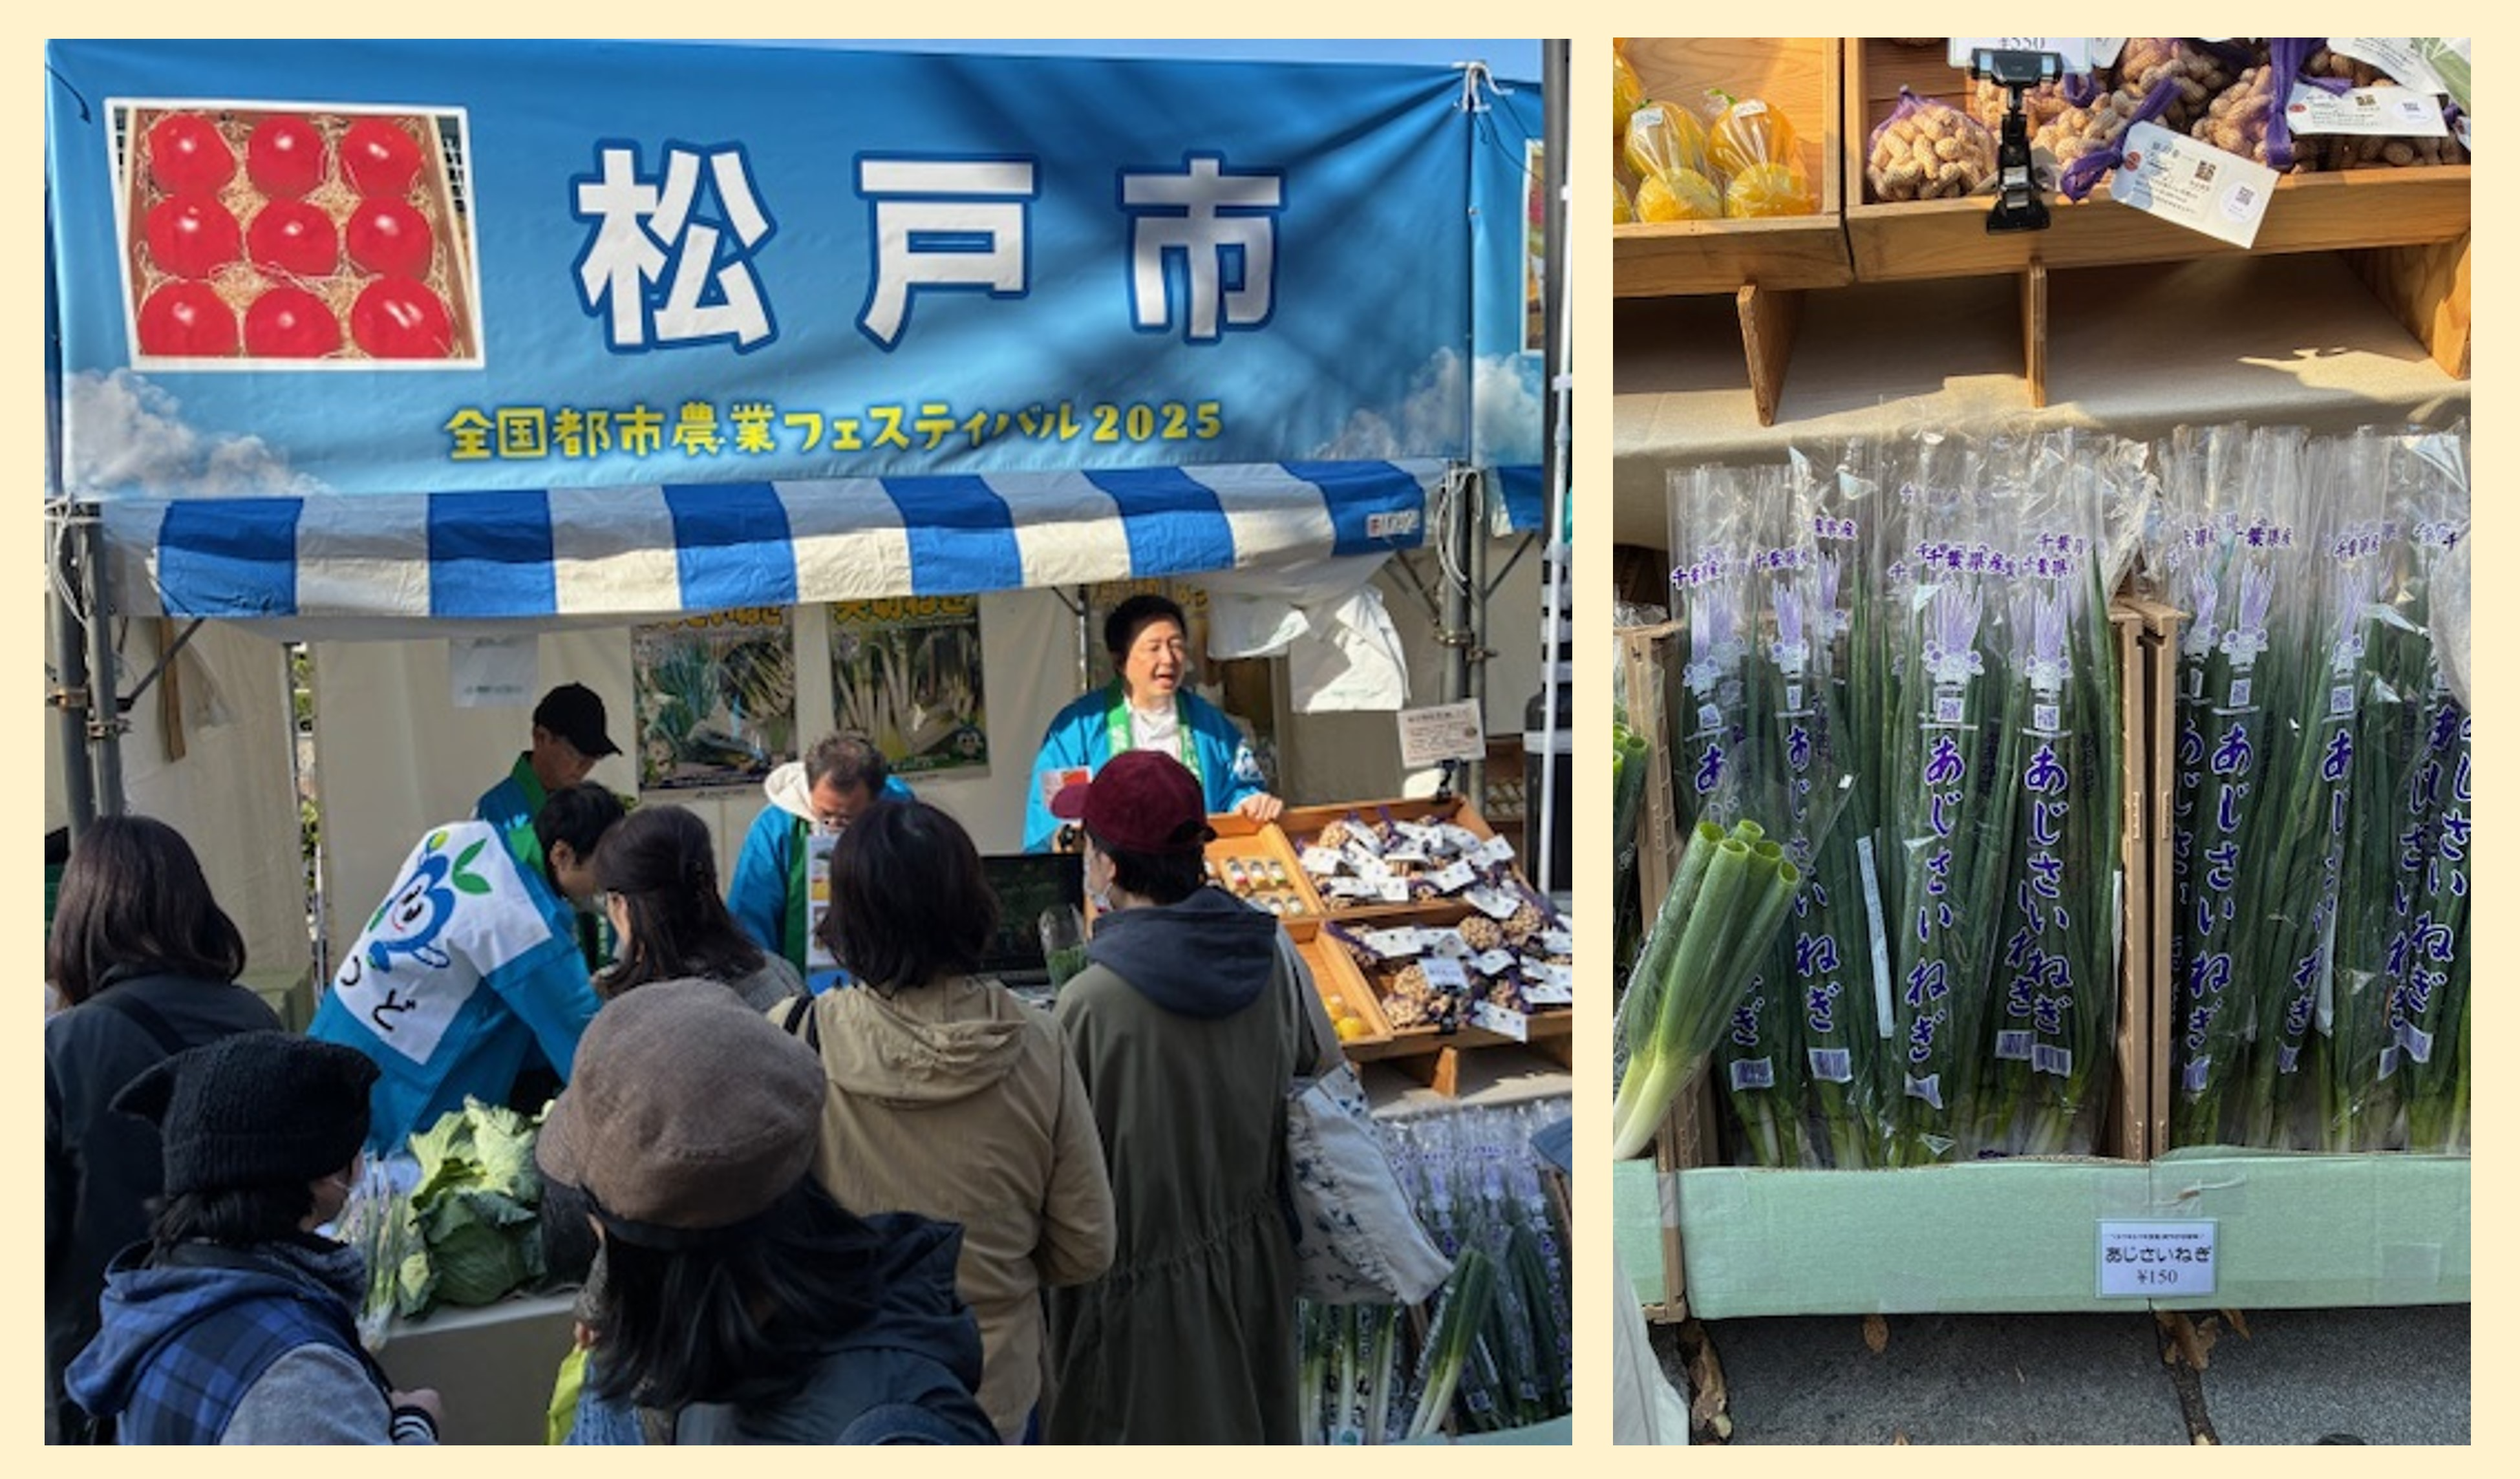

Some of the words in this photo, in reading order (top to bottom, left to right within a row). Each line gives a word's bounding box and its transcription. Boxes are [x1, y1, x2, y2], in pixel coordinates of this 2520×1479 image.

[573, 144, 1285, 350] 松戸市
[1927, 548, 2003, 571] 千葉県産
[1902, 733, 1967, 1063] あじさいねぎ
[2021, 743, 2075, 1036] あじさいねぎ
[2187, 721, 2254, 1051] あじさいねぎ
[2105, 1245, 2212, 1264] あじさいねぎ
[2137, 1269, 2179, 1285] ¥150
